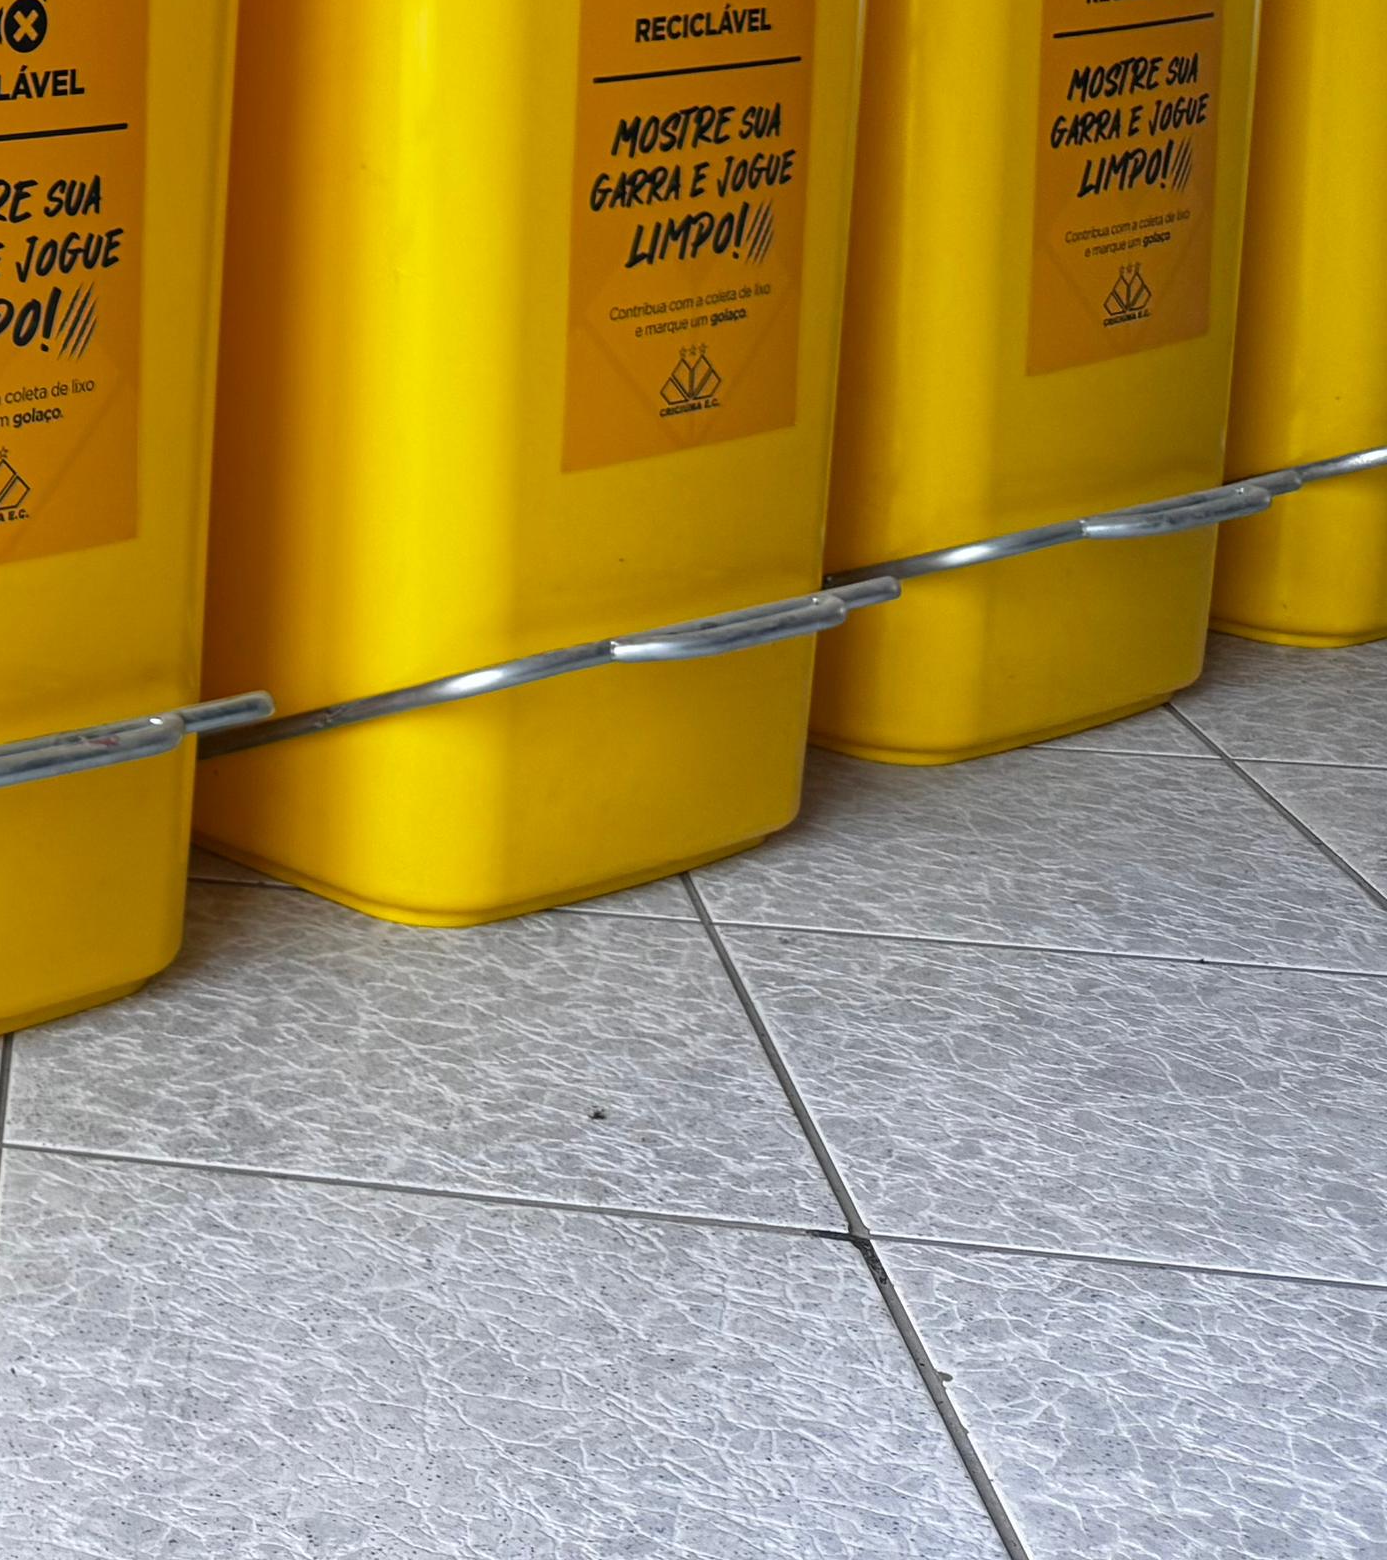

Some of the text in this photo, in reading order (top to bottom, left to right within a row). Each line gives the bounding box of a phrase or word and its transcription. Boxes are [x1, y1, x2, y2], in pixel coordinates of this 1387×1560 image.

[635, 3, 771, 42] RECICLÁVEL
[1067, 53, 1199, 103] MOSTRE SUA
[611, 102, 781, 158] MOSTRE SUA
[1050, 93, 1210, 149] GARRA E JOGUE
[589, 149, 796, 211] GARRA E JOGUE
[1077, 139, 1174, 198] LIMPO!
[44, 174, 102, 218] SUA
[15, 227, 124, 283] JOGUE
[625, 201, 750, 268] LIMPO!
[4, 384, 47, 405] coleta
[51, 381, 68, 397] de
[72, 377, 95, 394] lixo
[13, 404, 64, 429] golaço.
[8, 508, 30, 521] E.C.
